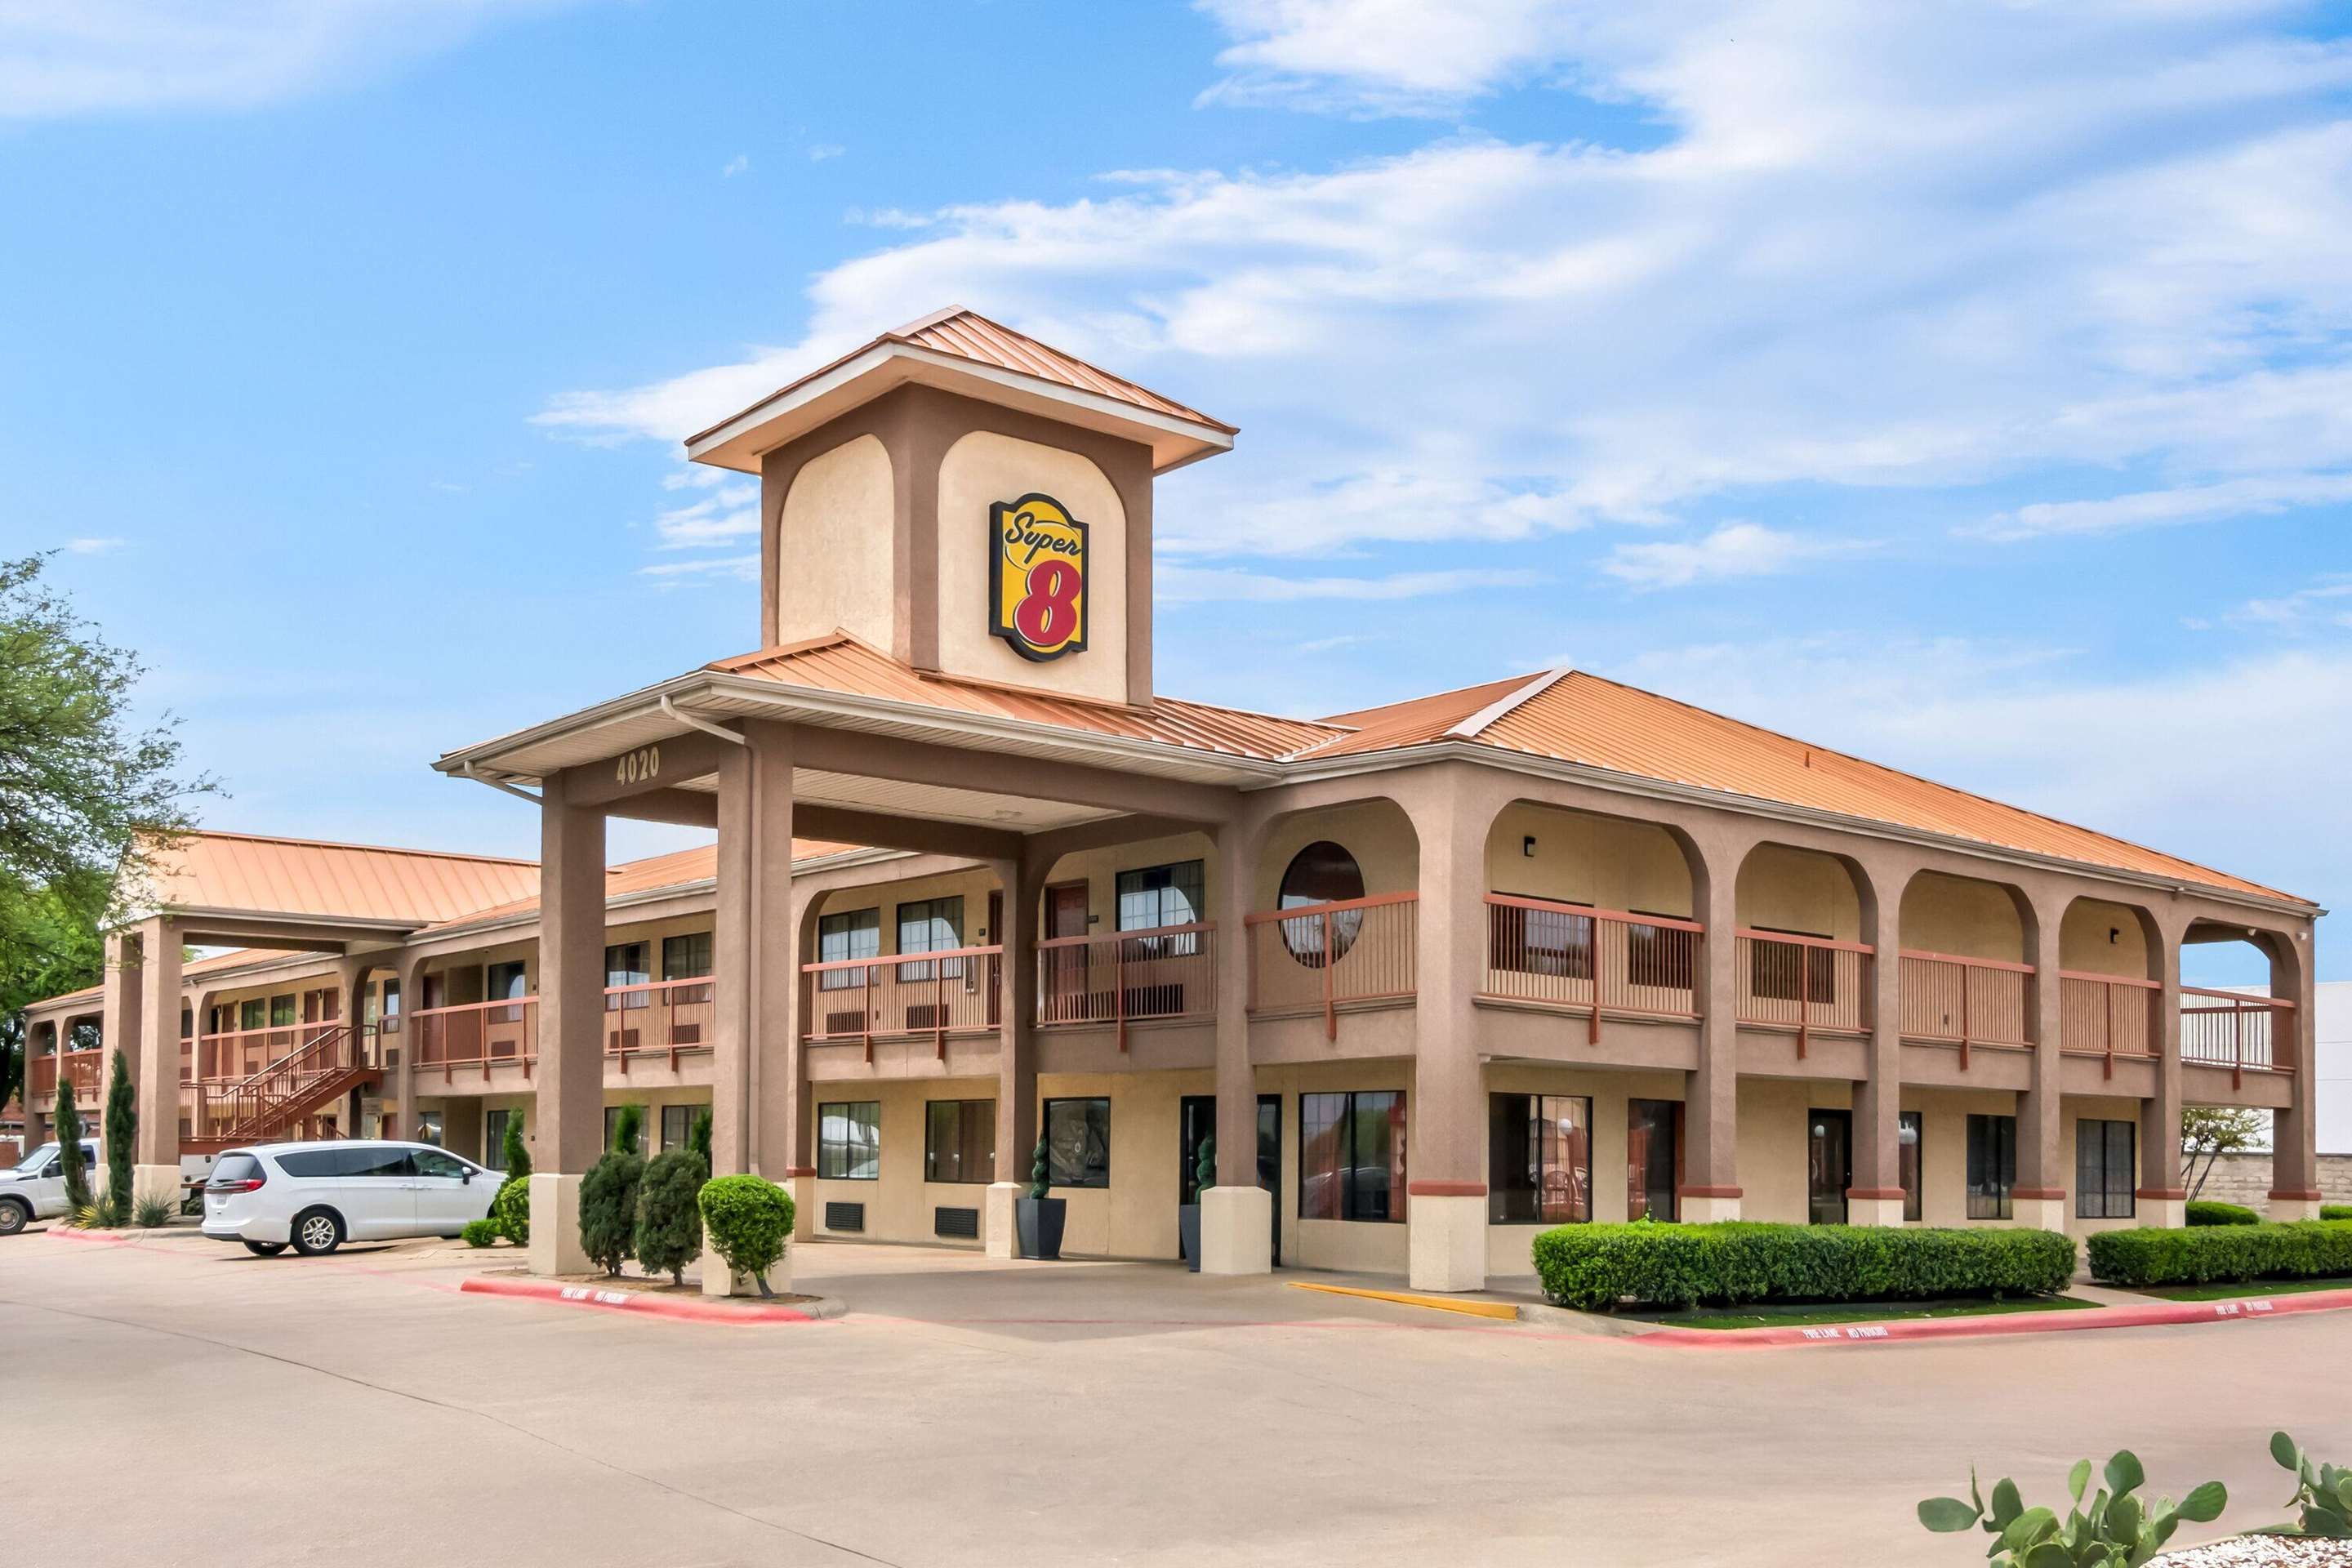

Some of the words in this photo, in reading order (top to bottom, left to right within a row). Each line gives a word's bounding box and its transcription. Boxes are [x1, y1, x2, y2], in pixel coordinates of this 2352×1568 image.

[1005, 511, 1081, 564] Super
[1013, 560, 1082, 646] 8
[617, 746, 659, 785] 4020
